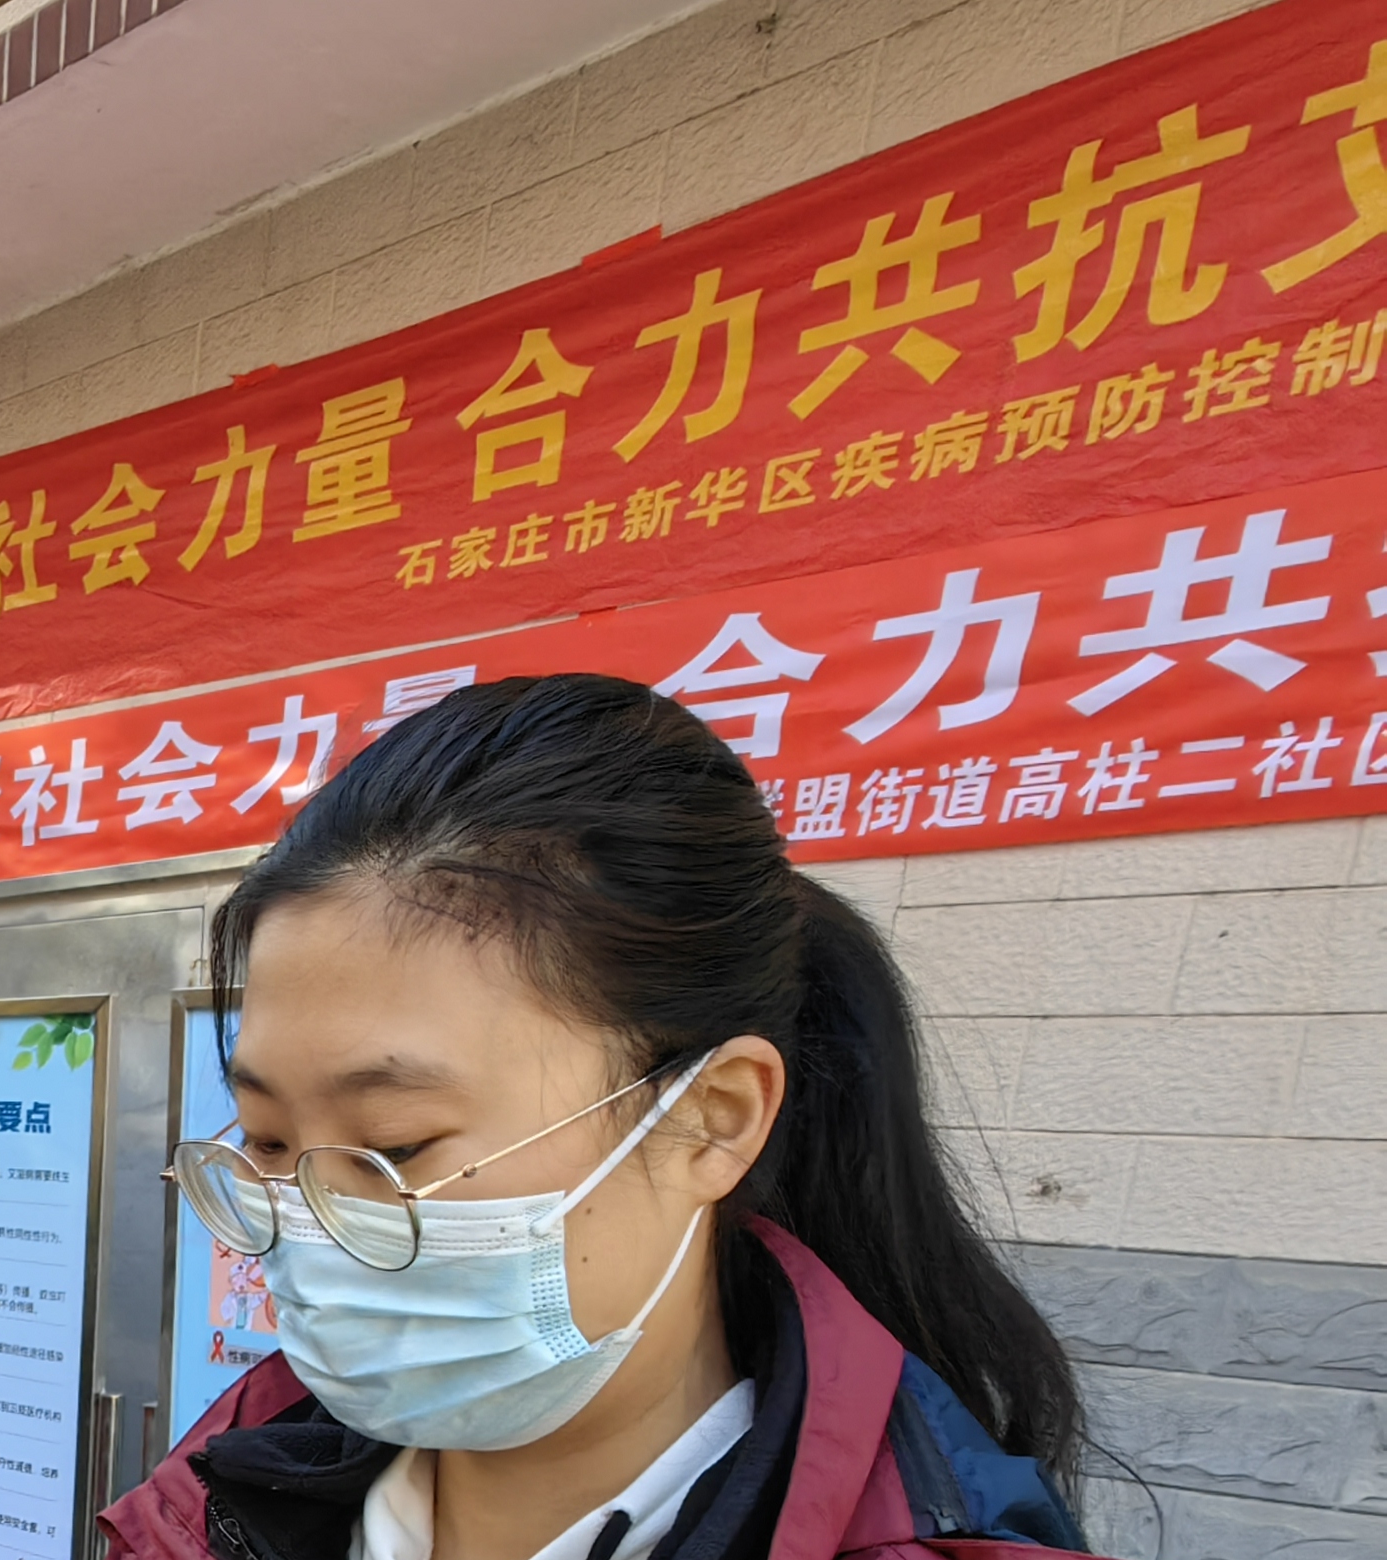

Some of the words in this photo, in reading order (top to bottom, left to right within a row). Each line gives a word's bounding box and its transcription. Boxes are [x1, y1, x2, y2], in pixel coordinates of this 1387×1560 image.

[395, 307, 1387, 589] 石家庄市新华区疾病预防控制
[651, 507, 1387, 760] 合力共
